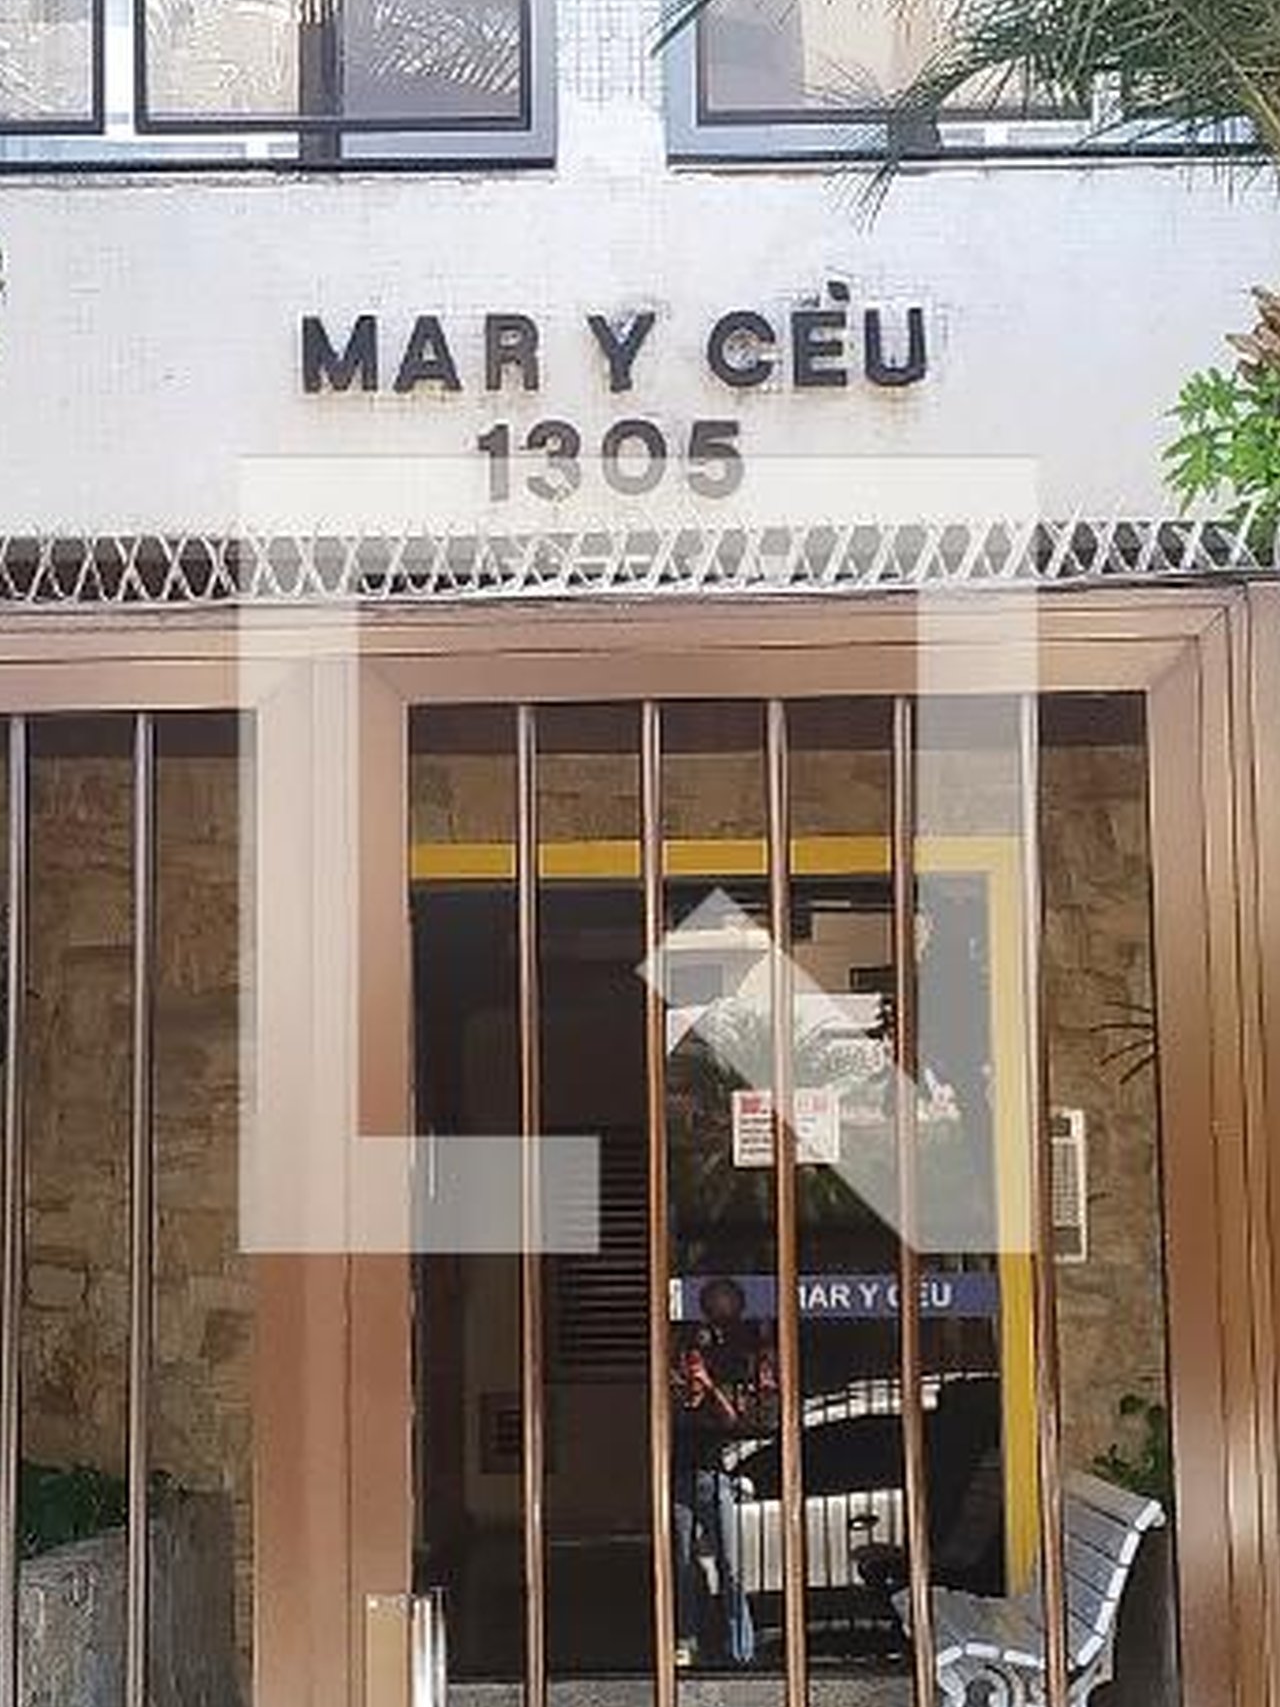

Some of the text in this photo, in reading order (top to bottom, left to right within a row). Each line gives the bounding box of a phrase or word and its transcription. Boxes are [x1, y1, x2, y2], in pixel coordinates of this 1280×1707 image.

[301, 313, 540, 392] MAR
[587, 311, 656, 391] Y
[476, 418, 745, 501] 1305
[797, 1282, 851, 1310] AR
[858, 1281, 880, 1309] Y
